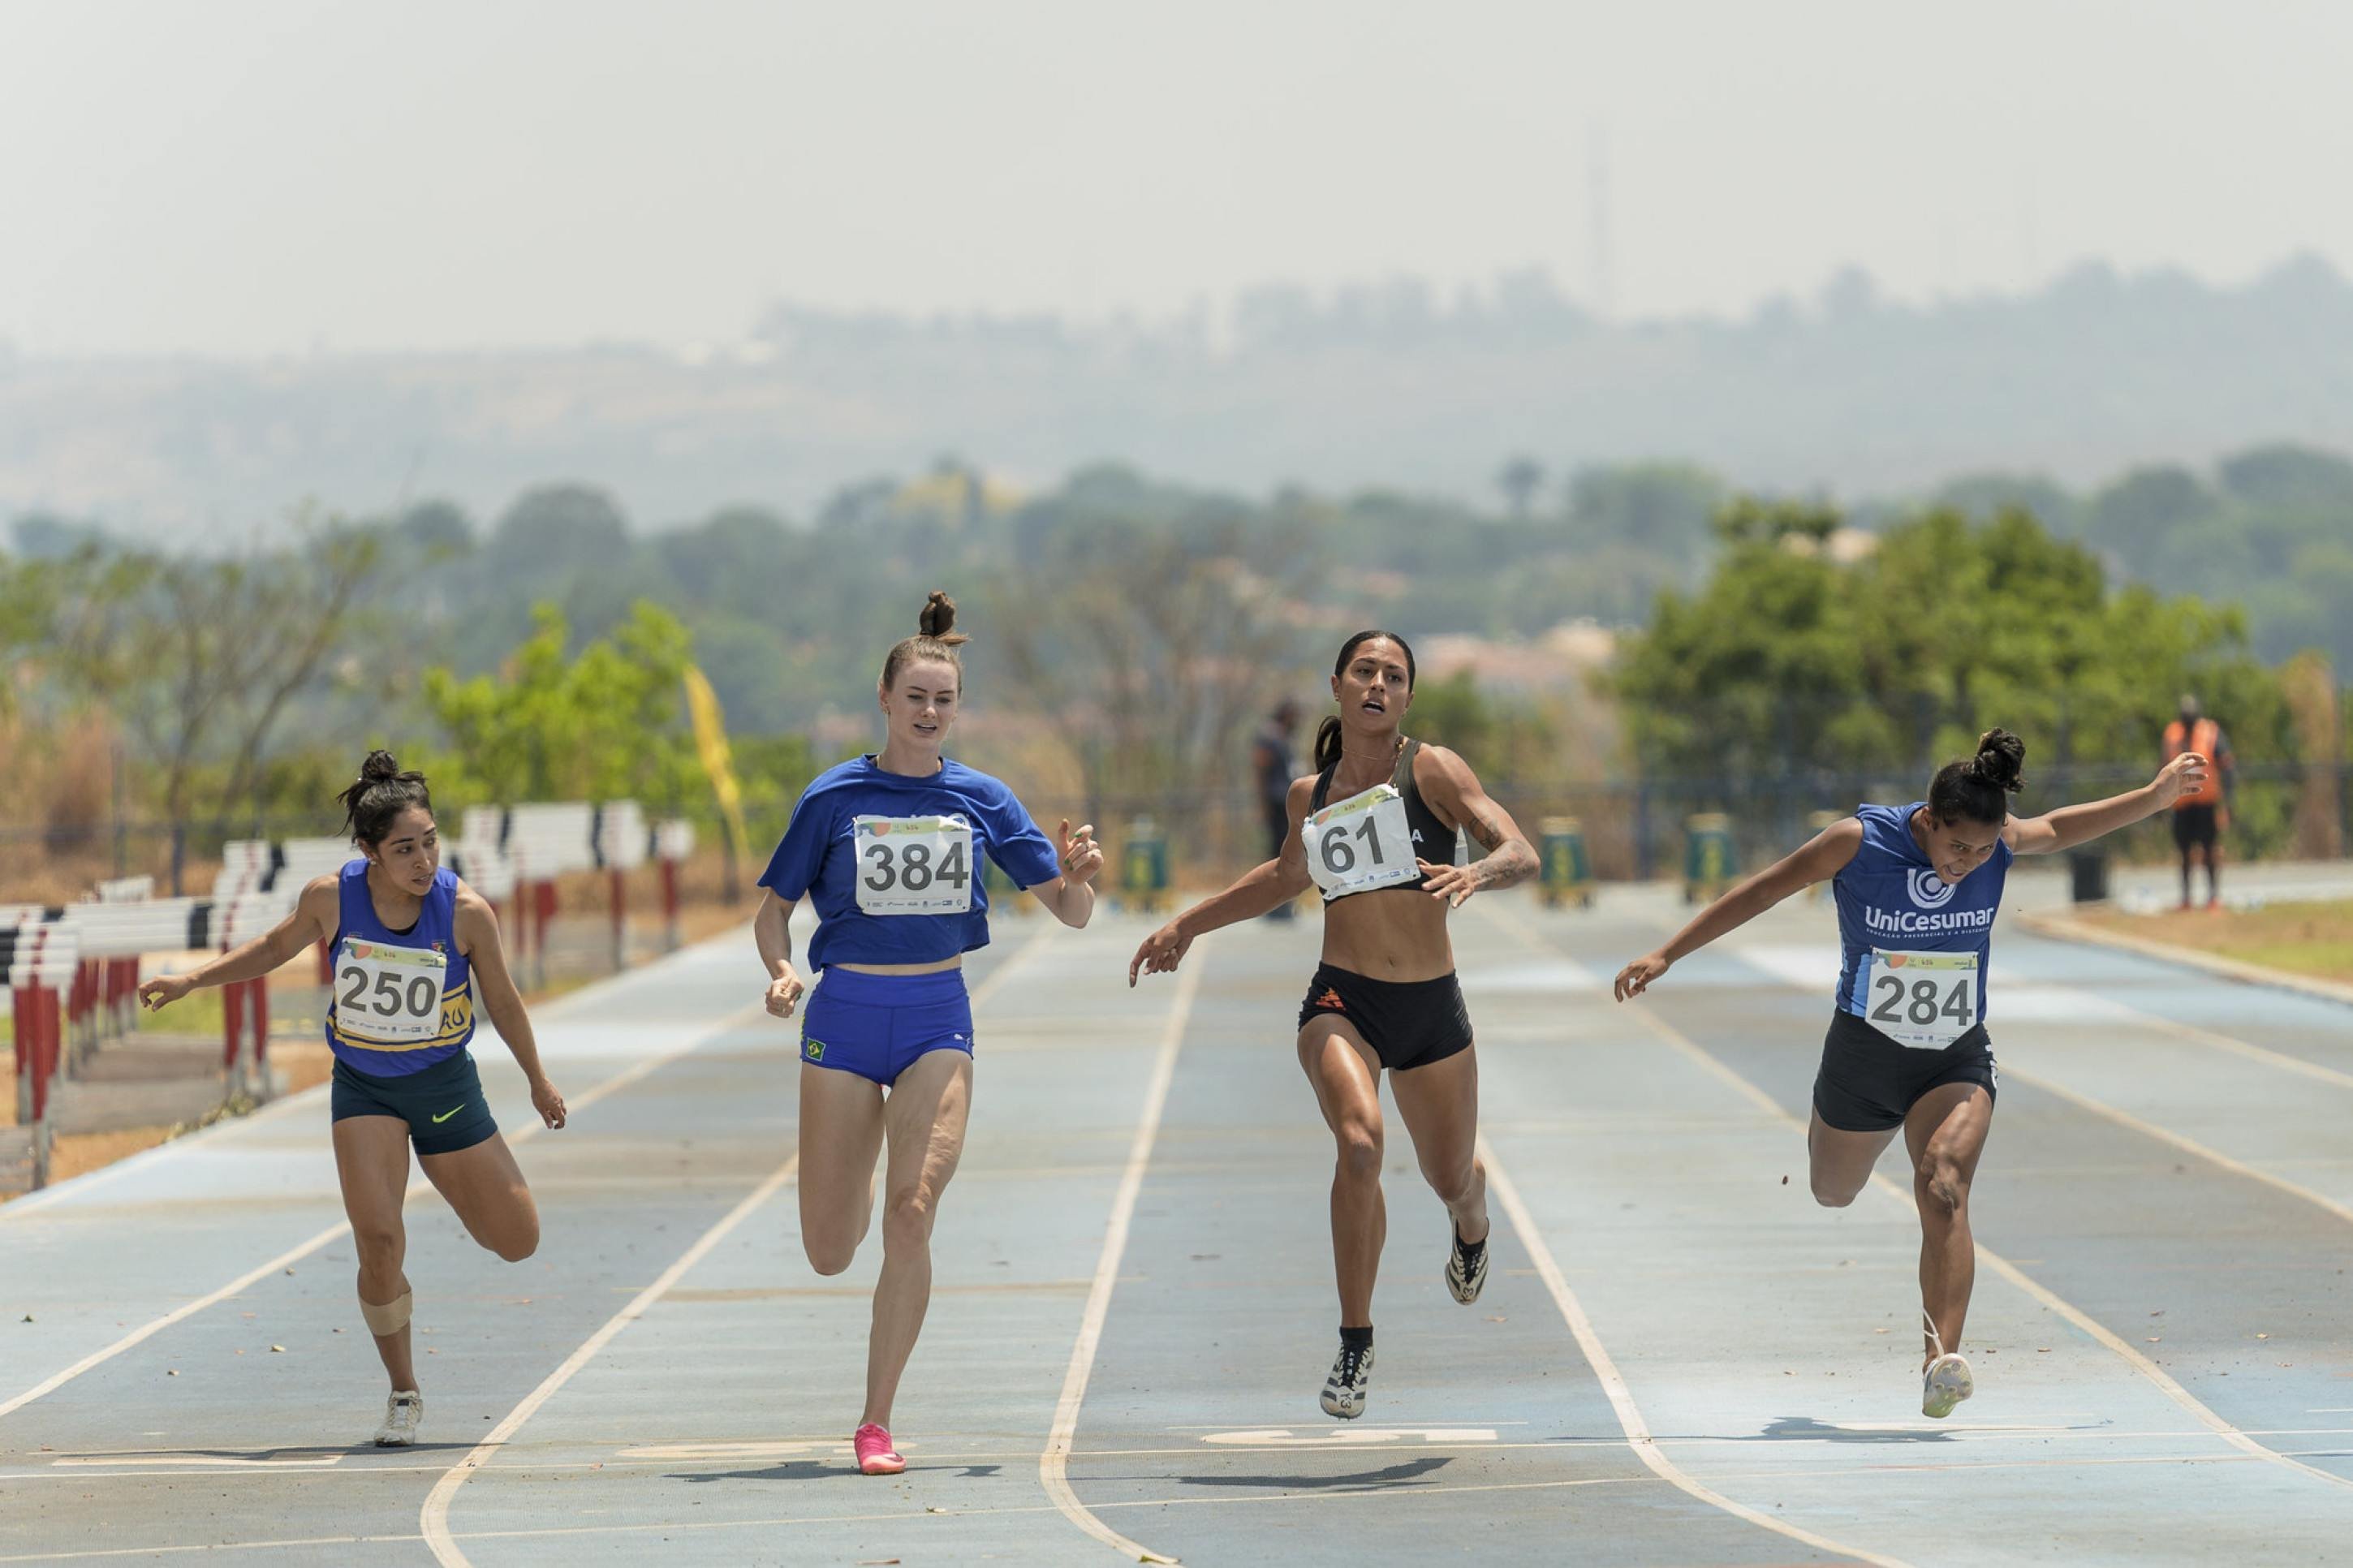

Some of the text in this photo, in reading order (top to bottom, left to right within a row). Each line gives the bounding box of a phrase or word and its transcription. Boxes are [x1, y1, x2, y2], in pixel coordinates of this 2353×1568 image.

[864, 842, 968, 891] 384
[1321, 816, 1383, 873] 61
[1865, 905, 1994, 932] UniCesumar
[341, 967, 436, 1017] 250
[1872, 976, 1972, 1026] 284
